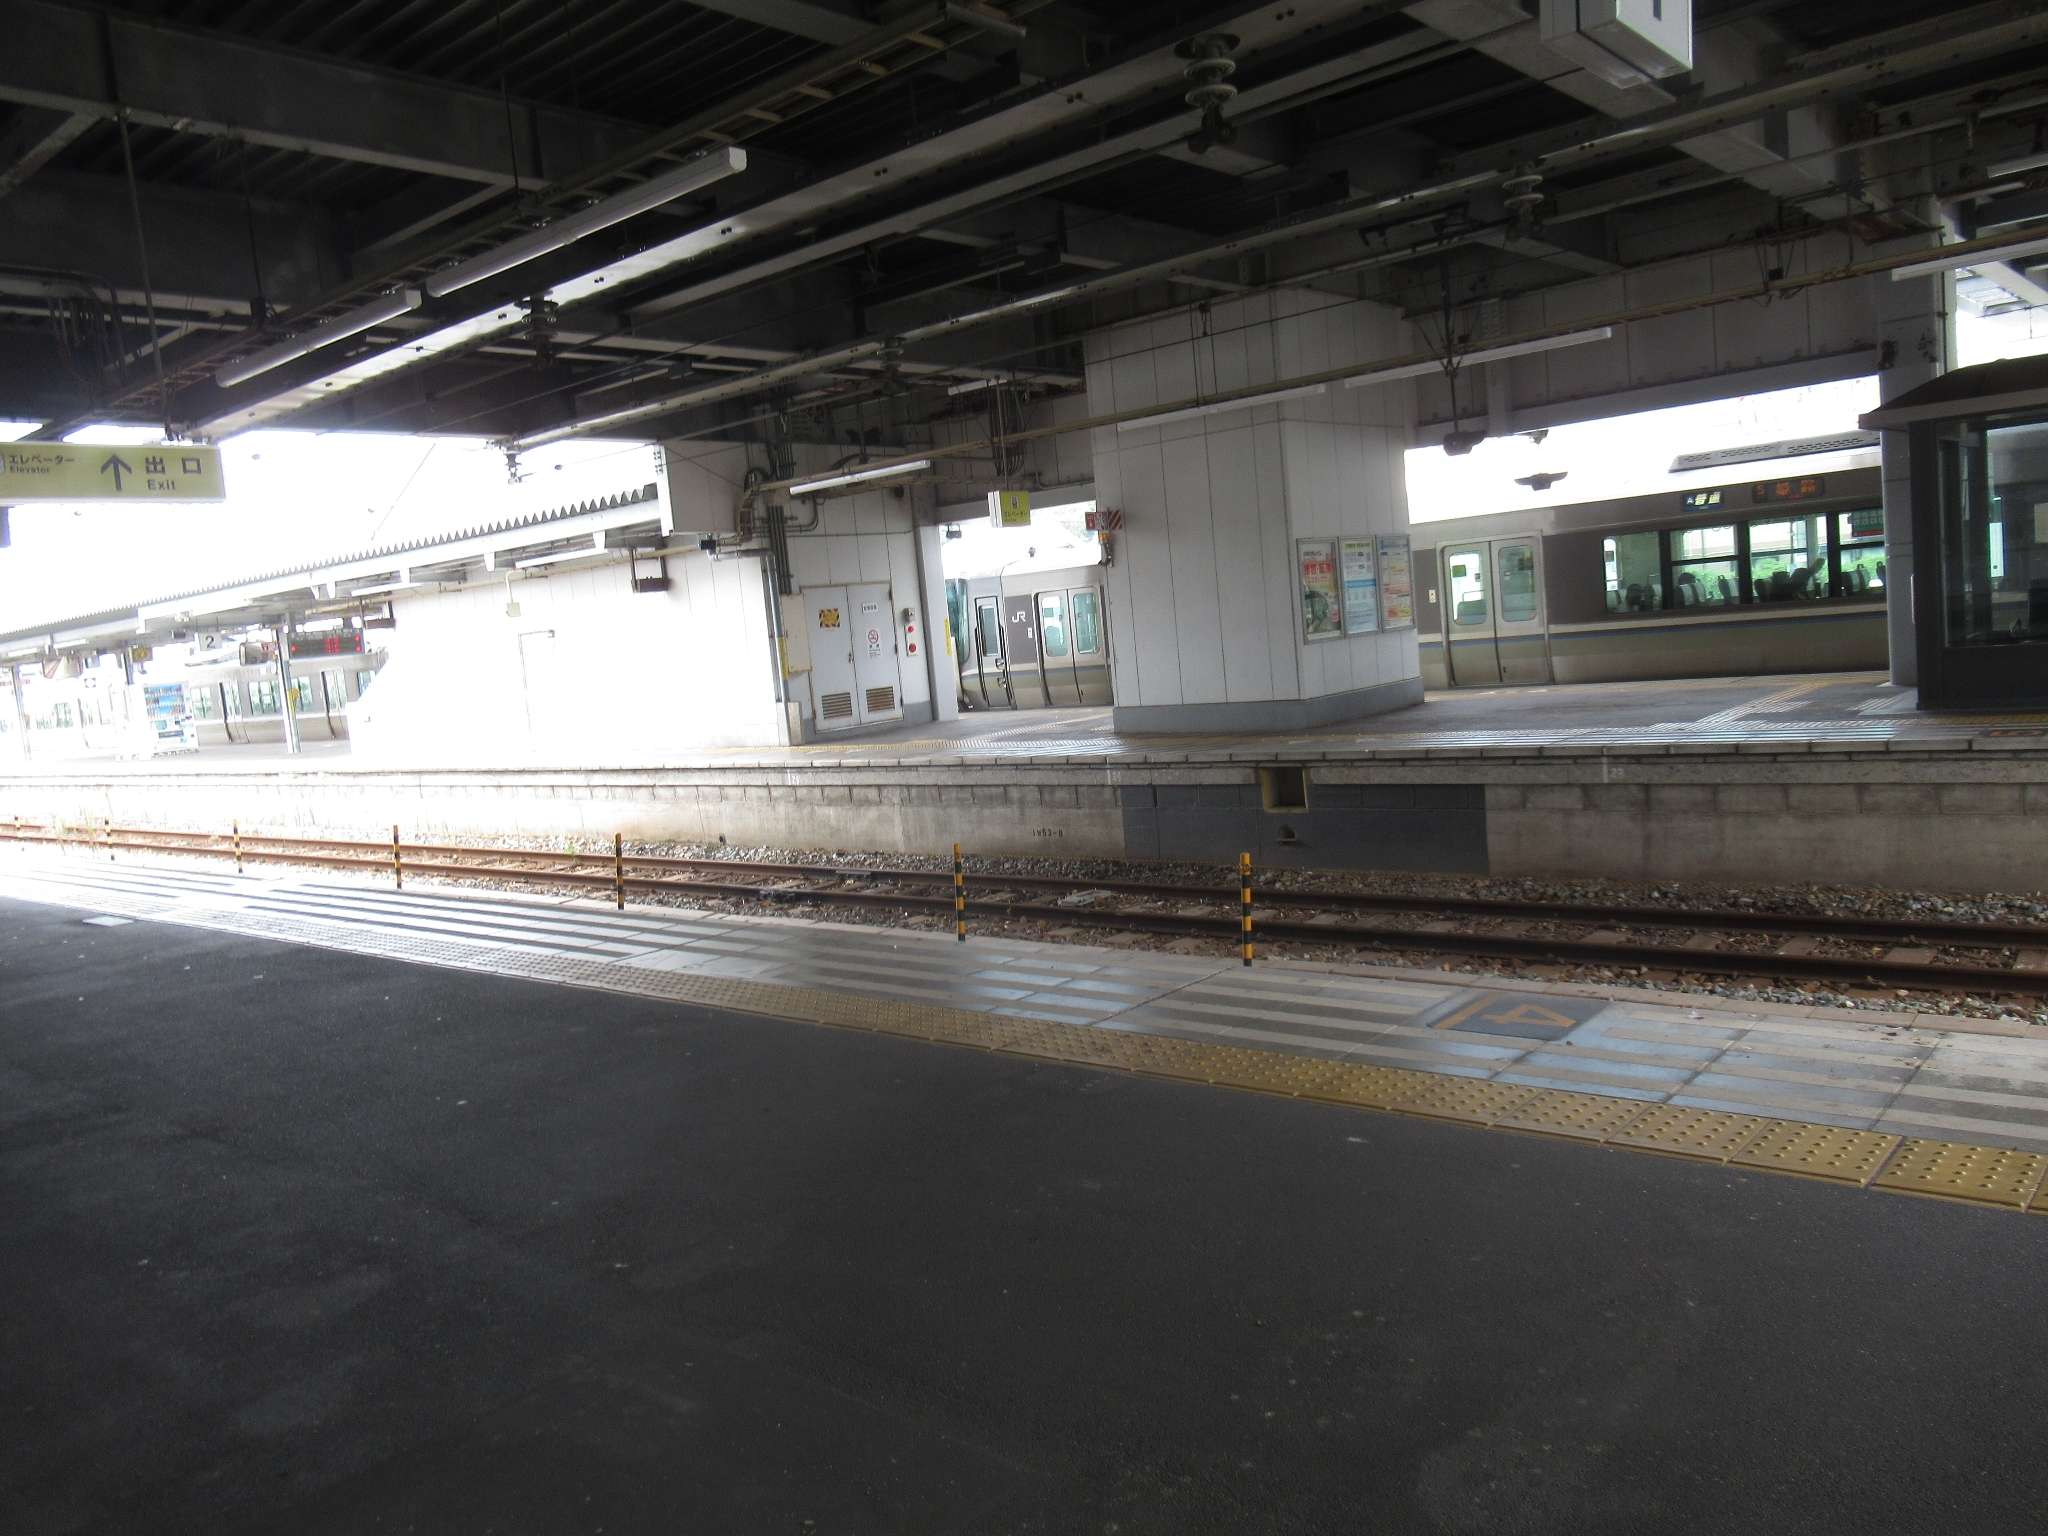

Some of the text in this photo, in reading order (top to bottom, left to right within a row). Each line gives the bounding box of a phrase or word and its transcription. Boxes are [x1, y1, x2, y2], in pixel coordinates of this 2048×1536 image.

[9, 455, 76, 465] エレベーター
[145, 456, 202, 474] 出口
[10, 465, 49, 474] Elevator
[147, 479, 176, 491] Exit
[1011, 611, 1026, 623] JR
[204, 635, 215, 649] 2
